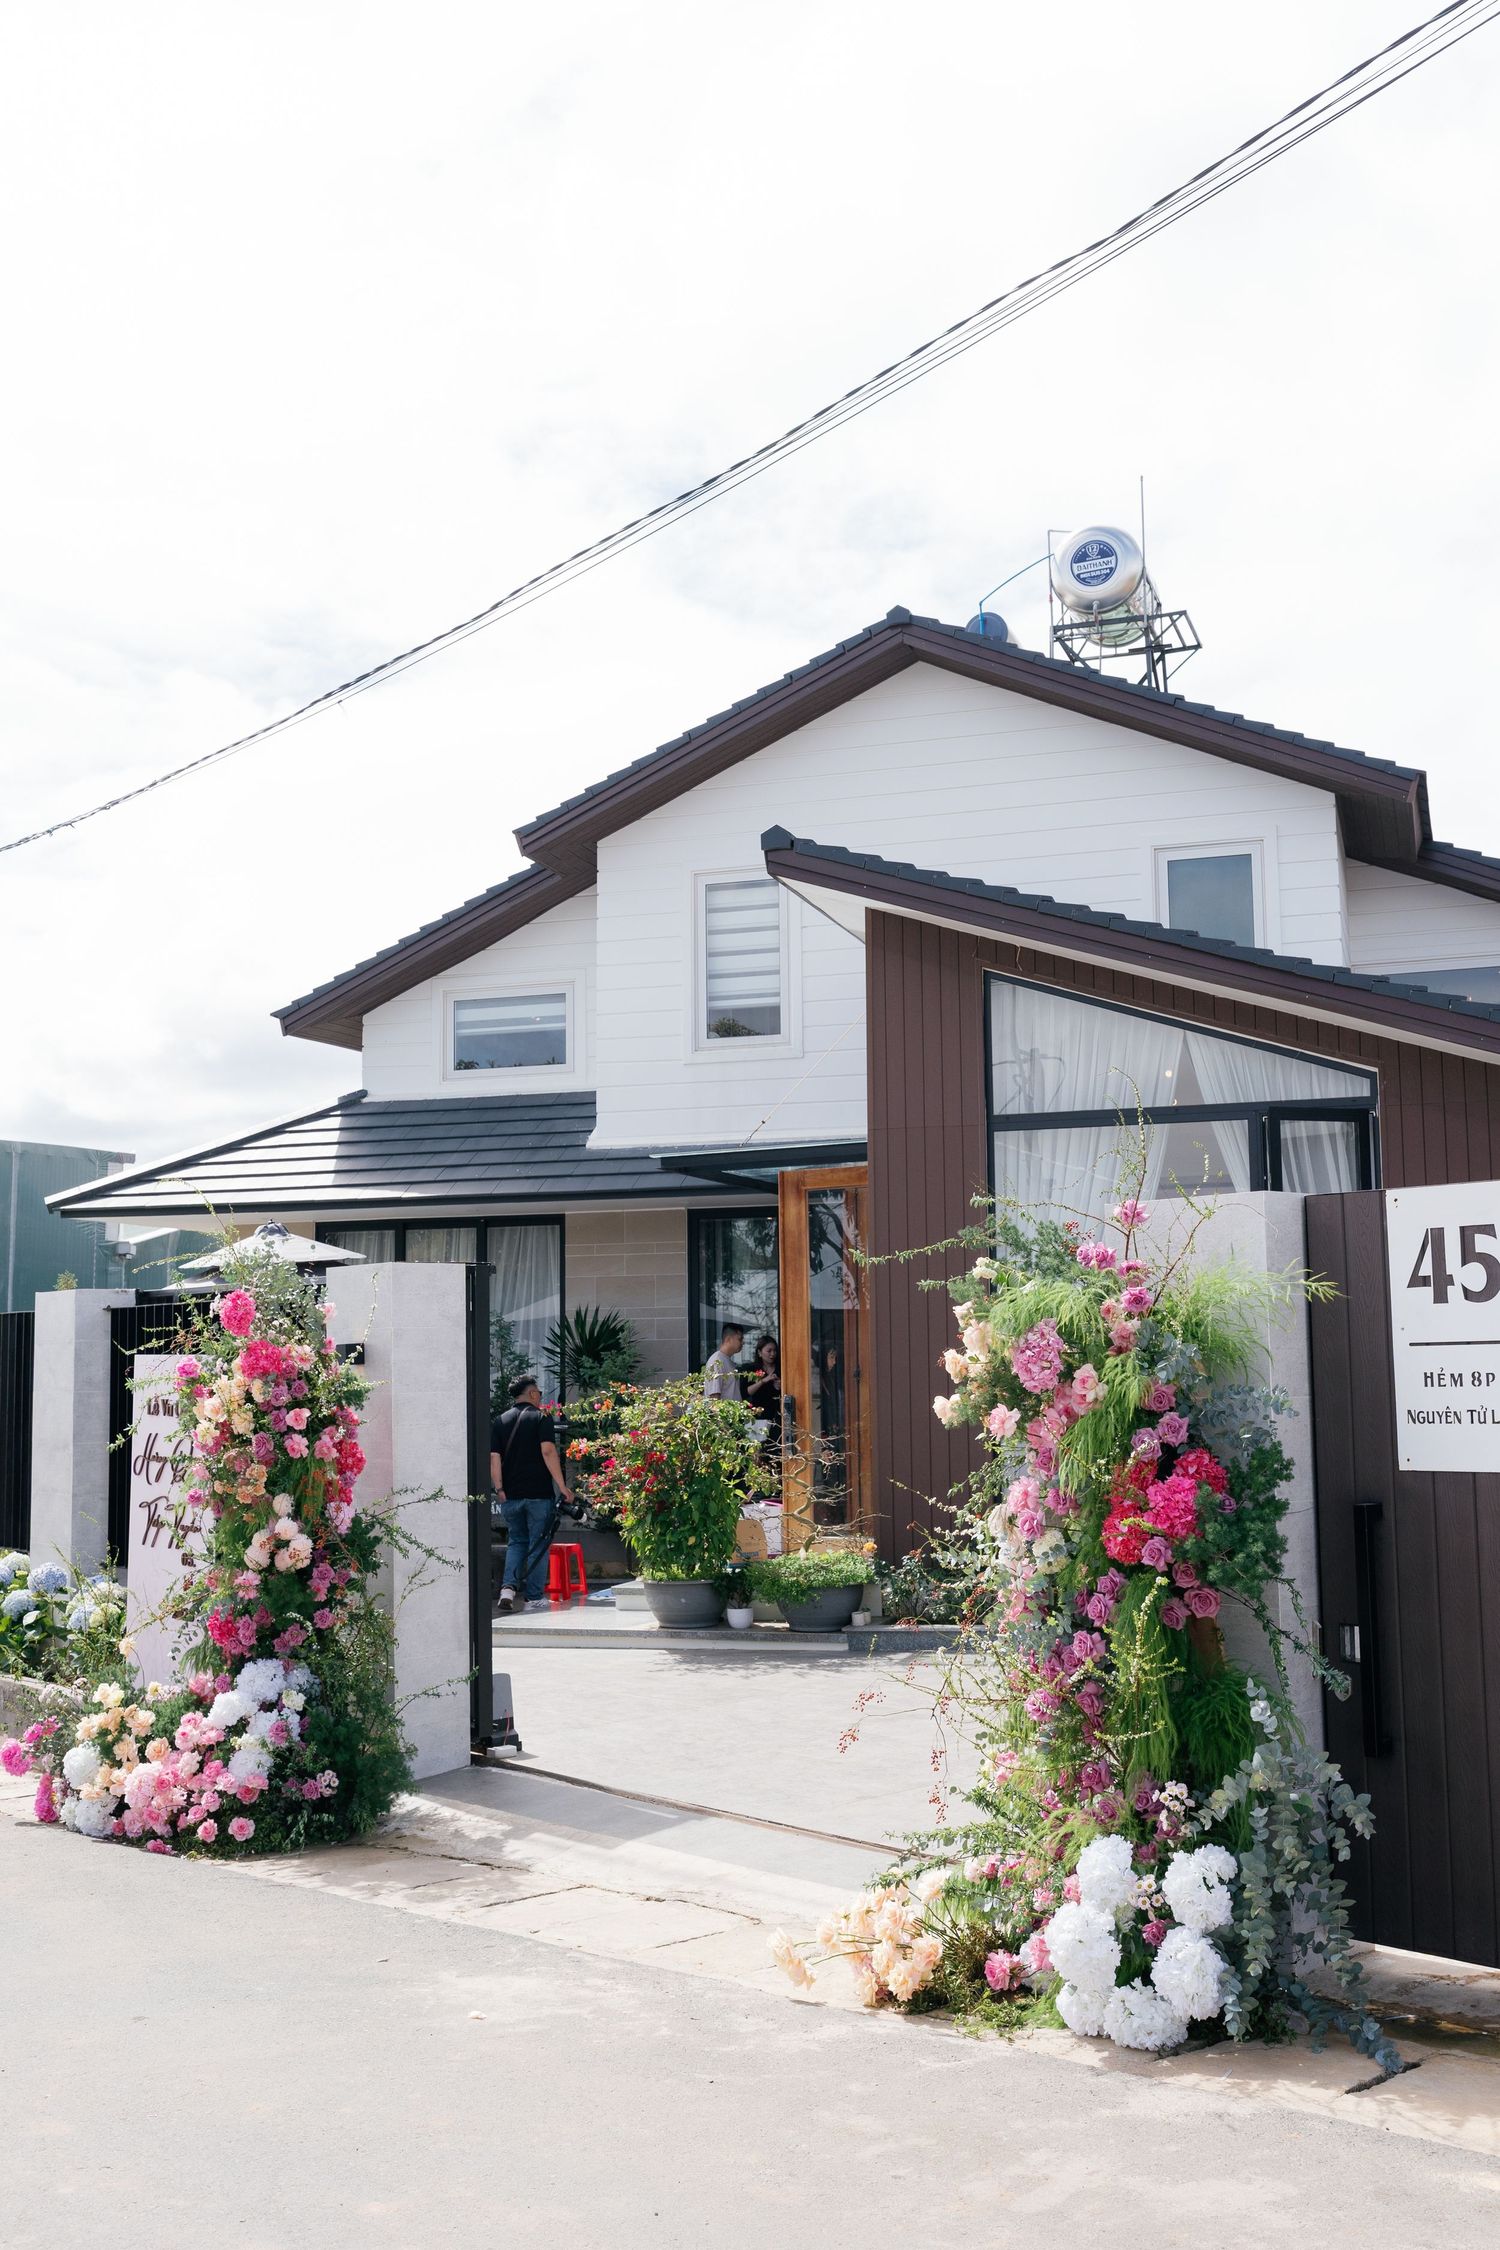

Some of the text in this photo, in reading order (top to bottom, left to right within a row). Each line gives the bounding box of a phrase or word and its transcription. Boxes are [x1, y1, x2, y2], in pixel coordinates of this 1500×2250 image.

[1406, 1223, 1500, 1304] 45
[1423, 1366, 1463, 1388] HẺM
[1407, 1405, 1462, 1425] NGUYÊN
[1467, 1404, 1488, 1425] TỬ
